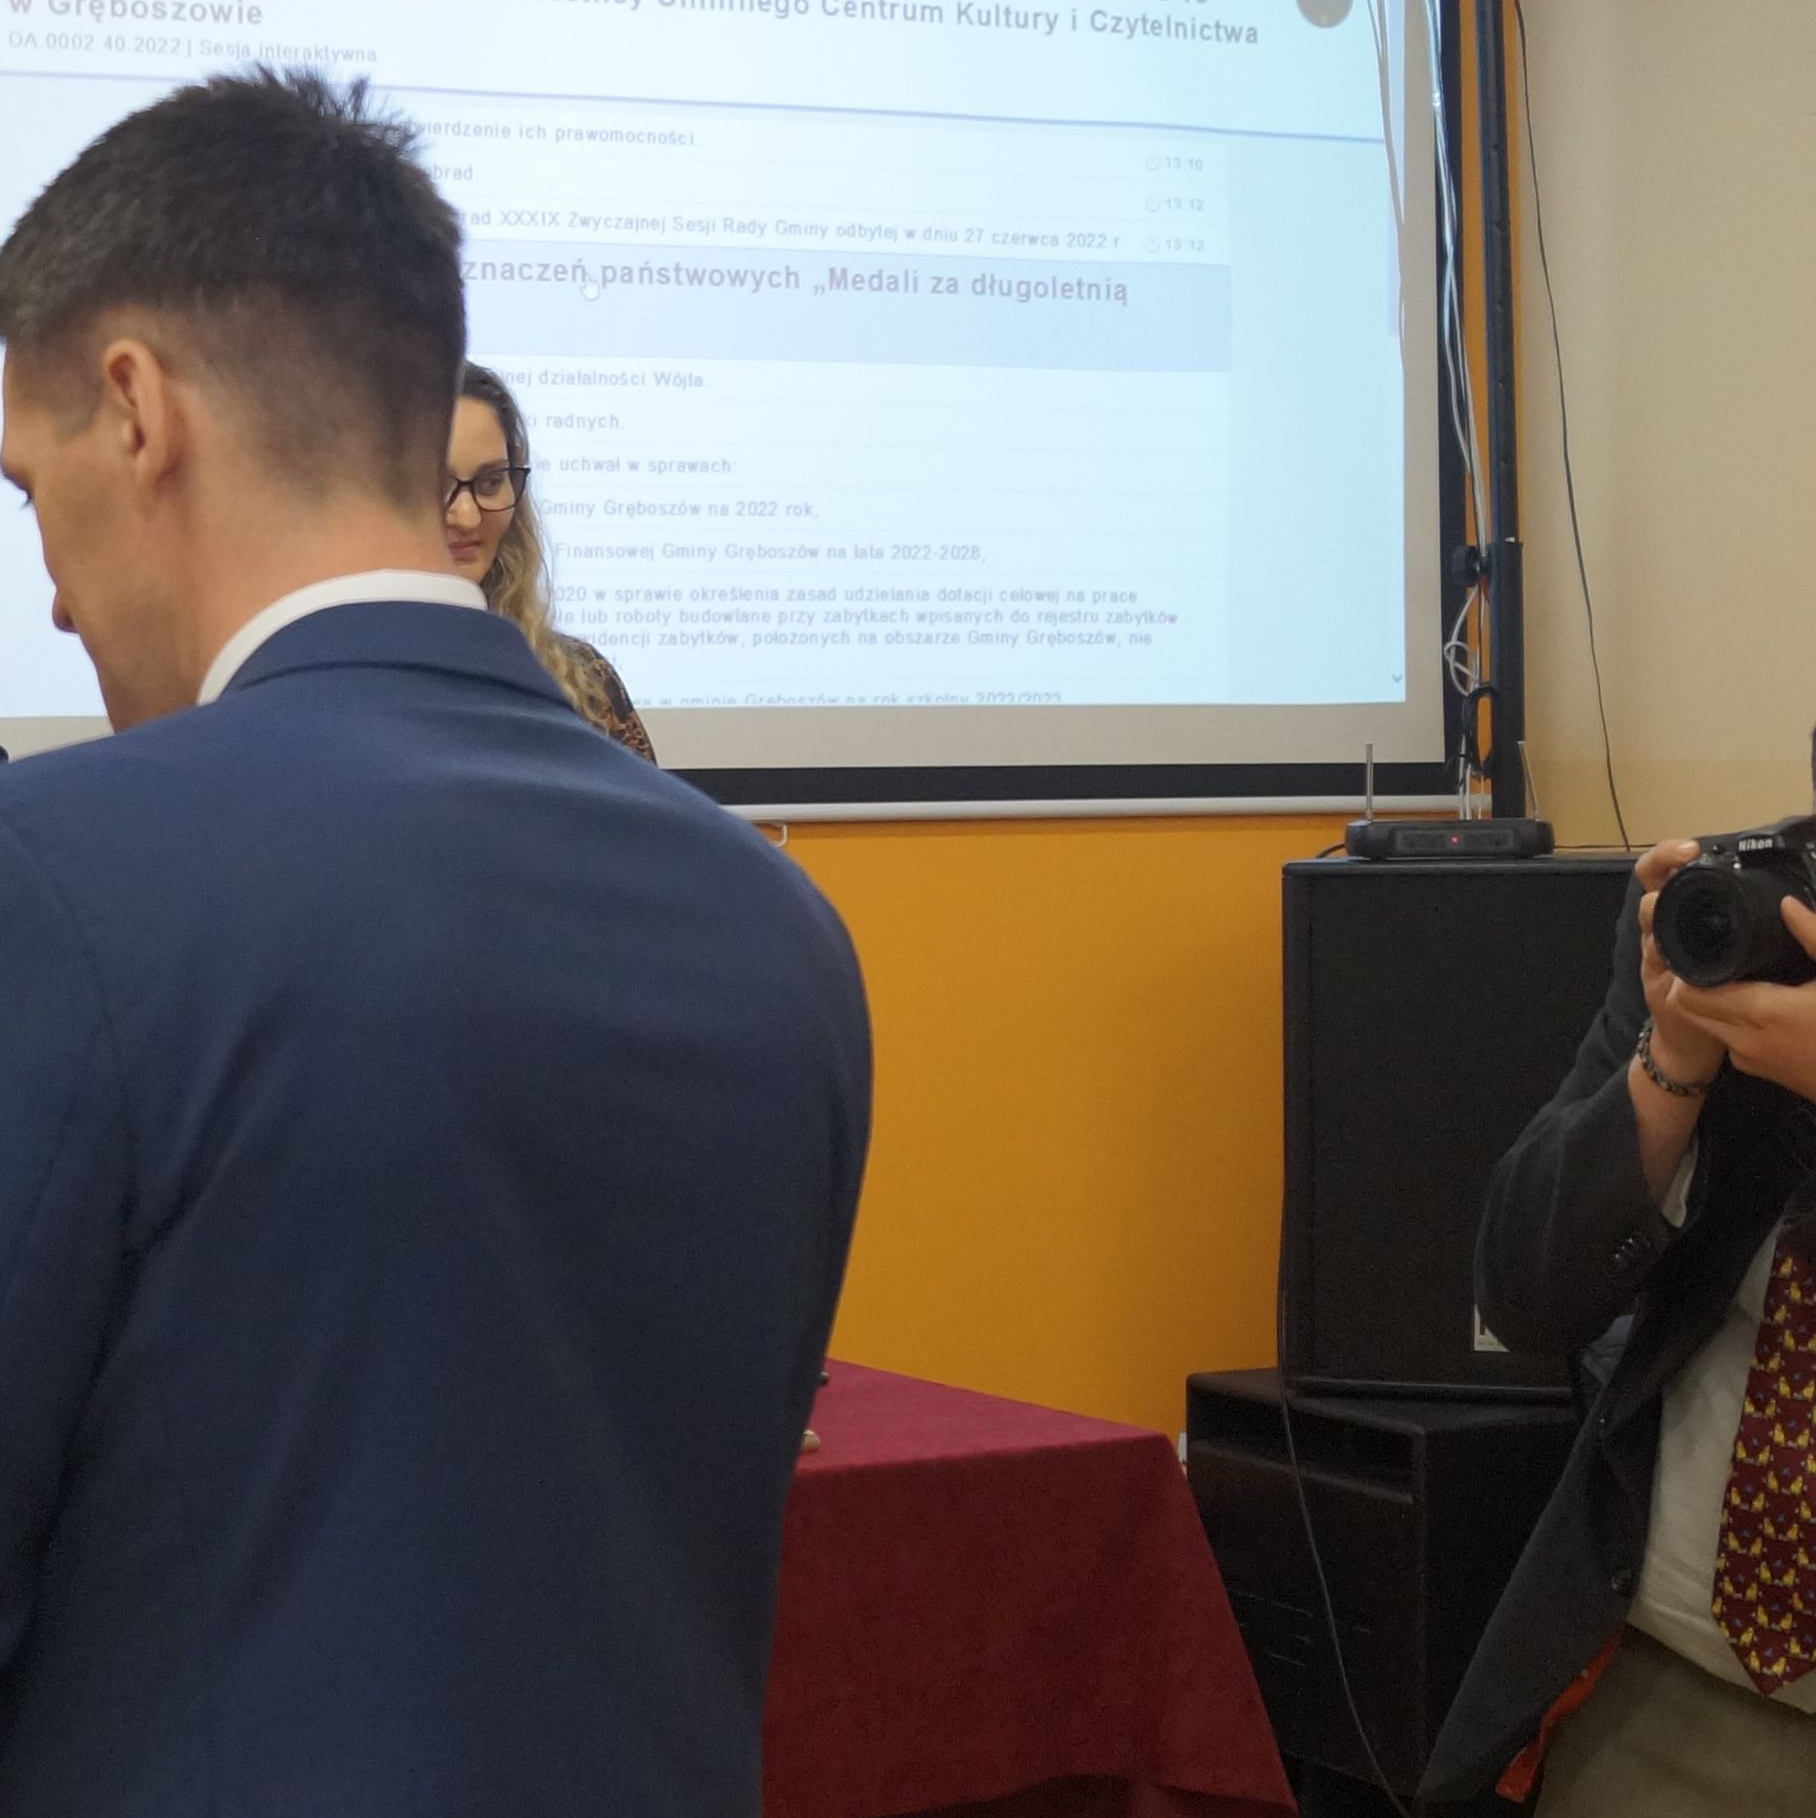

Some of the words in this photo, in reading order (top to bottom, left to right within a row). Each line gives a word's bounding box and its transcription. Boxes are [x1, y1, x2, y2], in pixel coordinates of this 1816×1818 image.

[956, 1, 1059, 36] Kultury
[1071, 8, 1078, 31] i
[1090, 10, 1259, 44] Czytelnictwa
[199, 40, 250, 59] Sesja
[259, 42, 377, 63] interaktywna
[519, 123, 546, 140] ich
[555, 124, 698, 146] prawomocności.
[500, 210, 560, 227] XXXIX
[568, 212, 665, 234] Zwyczajnej
[672, 216, 716, 236] Sesji
[723, 217, 767, 237] Rady
[776, 219, 829, 239] Gminy
[836, 222, 898, 243] odbytej
[905, 229, 916, 241] w
[923, 225, 957, 242] dniu
[965, 228, 984, 243] 27
[992, 232, 1059, 247] czerwca
[1066, 232, 1106, 249] 2022
[464, 258, 586, 282] znaczeń
[601, 260, 800, 293] państwowych
[813, 266, 919, 296] „Medali
[930, 276, 959, 294] za
[971, 273, 1128, 307] długoletnią
[538, 369, 645, 387] działalności
[546, 413, 625, 431] radnych.
[559, 456, 620, 472] uchwał
[628, 461, 639, 472] w
[647, 458, 735, 475] sprawach:
[540, 499, 596, 518] Gminy
[604, 498, 701, 518] Gręboszów
[708, 503, 729, 516] na
[736, 501, 778, 517] 2022
[786, 502, 819, 519] rok,
[555, 542, 655, 561] Finansowej
[663, 543, 716, 561] Gminy
[725, 543, 819, 562] Gręboszów
[827, 546, 846, 559] na
[595, 590, 608, 601] w
[615, 587, 682, 604] sprawie
[690, 585, 779, 601] określenia
[787, 586, 837, 602] zasad
[845, 587, 930, 602] udzielania
[937, 587, 993, 605] dotacji
[999, 587, 1059, 605] celowej
[1067, 590, 1085, 602] na
[1092, 589, 1138, 605] prace
[581, 608, 608, 623] lub
[616, 609, 671, 626] roboty
[680, 608, 772, 623] budowlane
[778, 611, 815, 626] przy
[823, 609, 909, 626] zabytkach
[916, 609, 1003, 626] wpisanych
[1010, 609, 1030, 623] do
[1037, 610, 1099, 626] rejestru
[857, 632, 878, 644] na
[885, 630, 960, 645] obszarze
[968, 629, 1019, 648] Gminy
[1129, 632, 1153, 645] nie
[1738, 837, 1773, 852] Nikon
